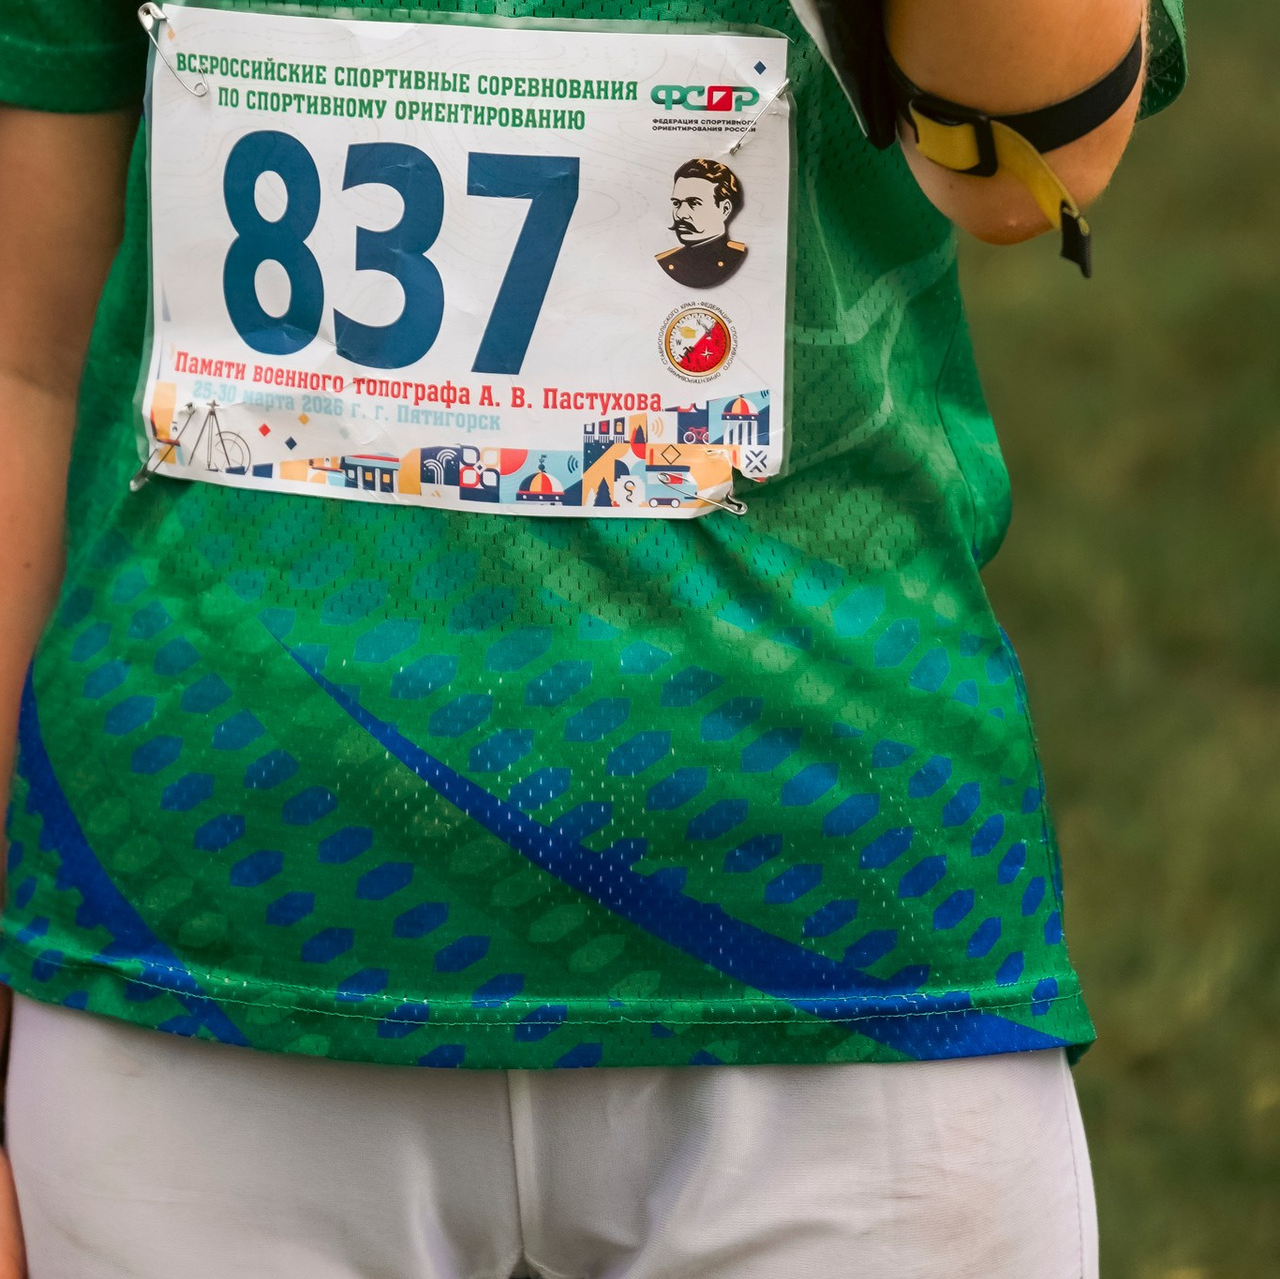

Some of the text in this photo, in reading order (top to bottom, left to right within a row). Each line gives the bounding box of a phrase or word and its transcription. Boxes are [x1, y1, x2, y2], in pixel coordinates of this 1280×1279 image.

[176, 52, 638, 101] ВСЕРОССИЙСКИЕ СПОРТИВНЫЕ СОРЕВНОВАНИЯ
[218, 86, 586, 130] ПО СПОРТИВНОМУ ОРИЕНТИРОВАНИЮ
[223, 129, 580, 375] 837
[174, 350, 662, 416] Памяти военного топографа А. В. Пастухова
[193, 379, 237, 403] 25-30
[242, 389, 295, 414] марта
[397, 405, 501, 433] Пятигорск
